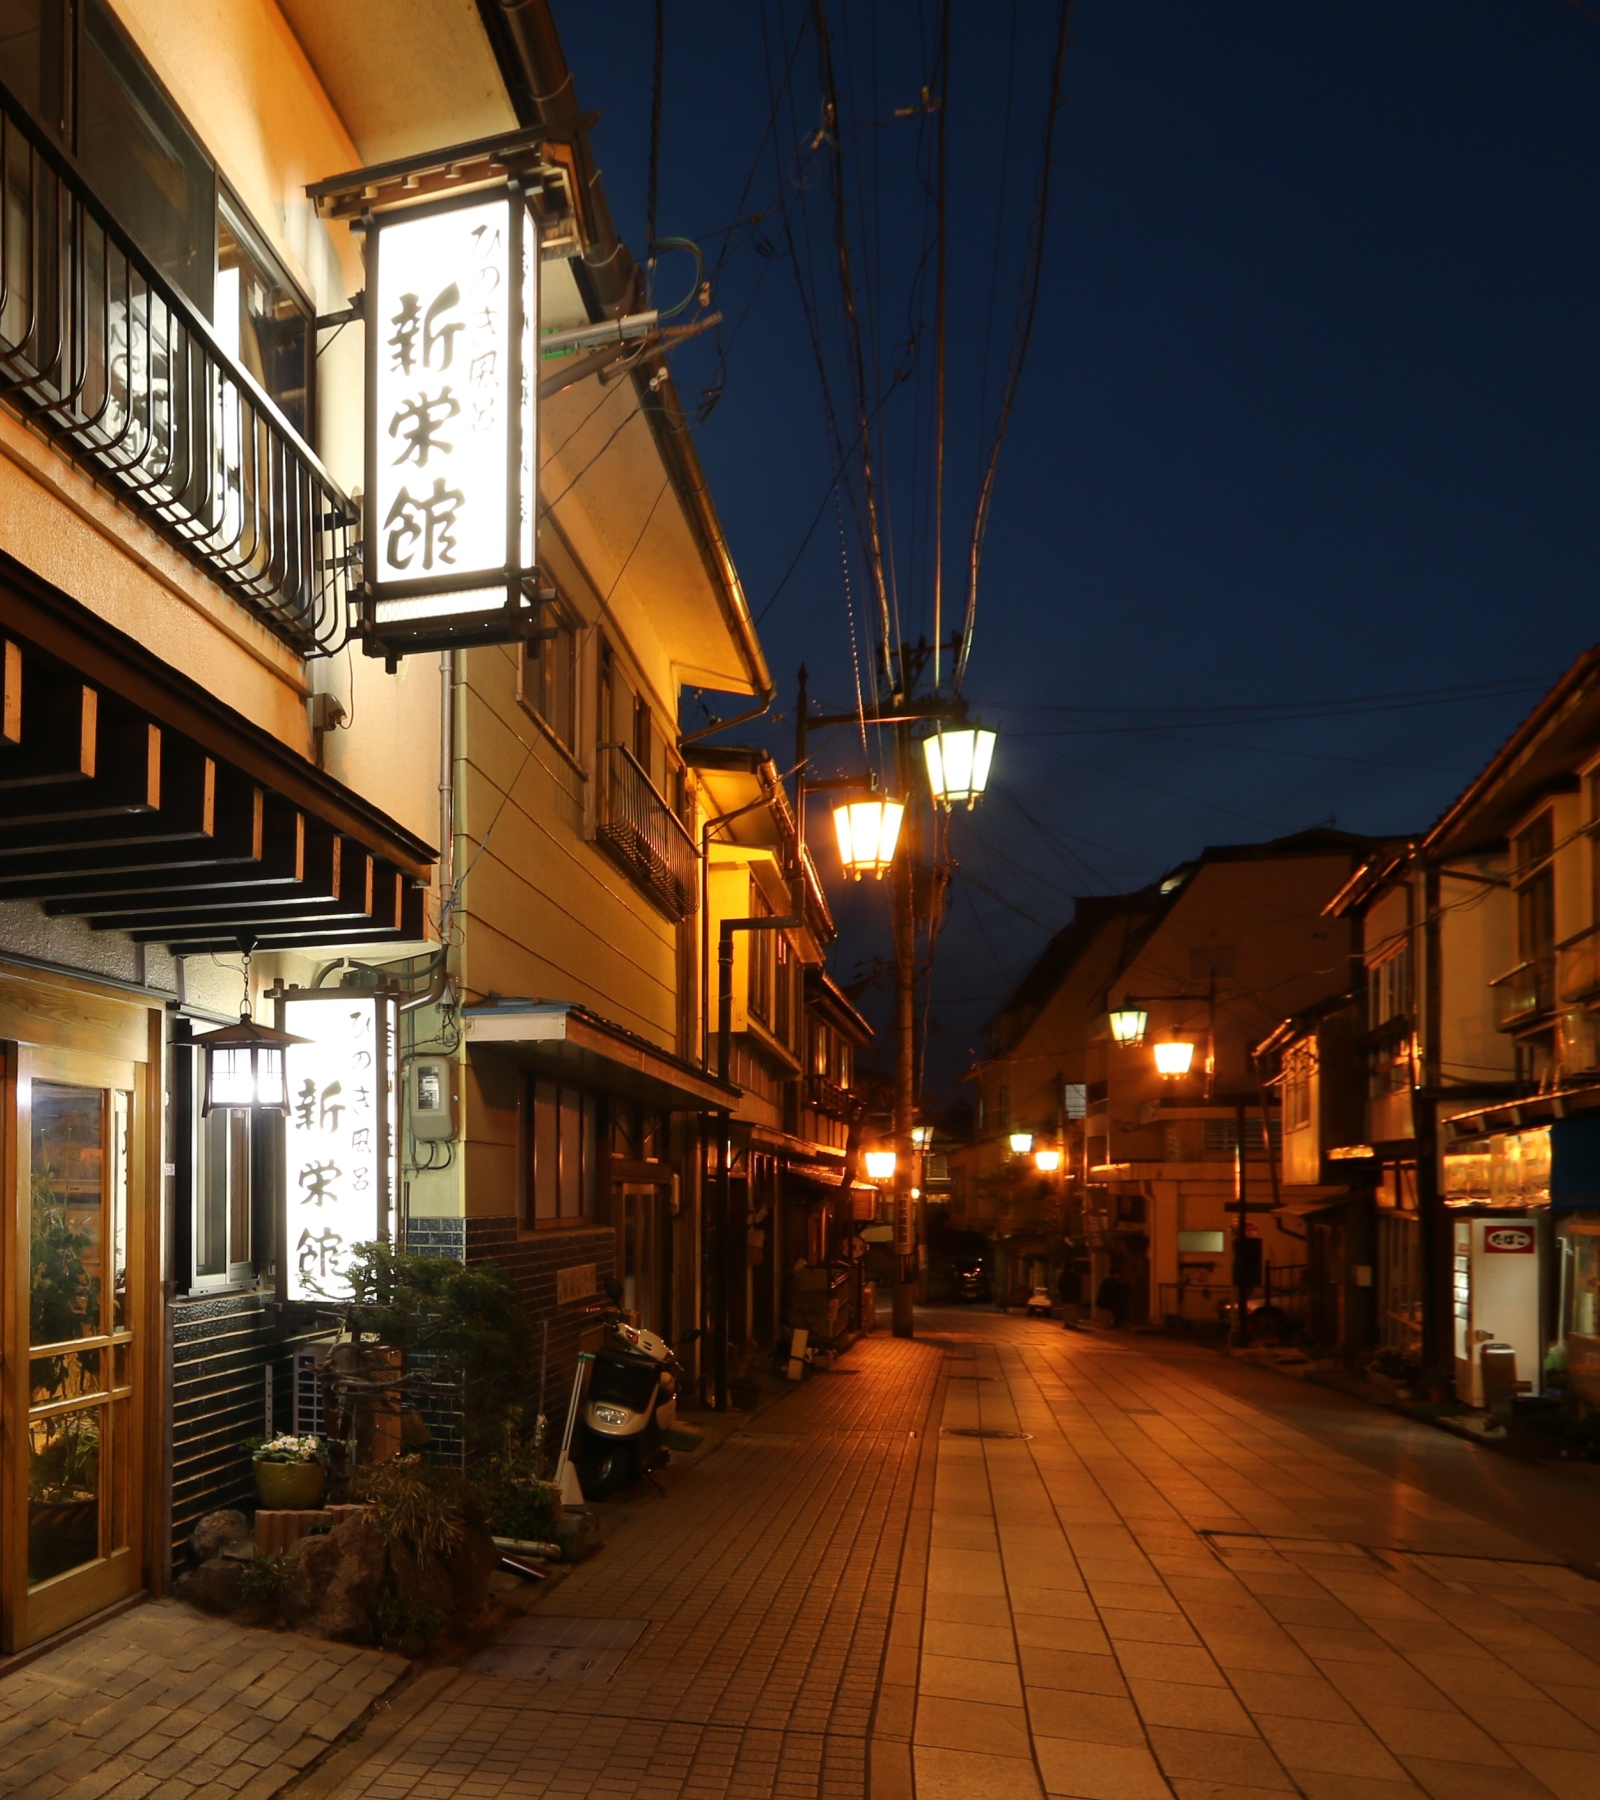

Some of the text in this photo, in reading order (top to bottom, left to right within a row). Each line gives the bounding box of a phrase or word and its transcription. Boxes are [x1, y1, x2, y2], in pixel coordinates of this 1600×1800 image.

[383, 281, 466, 571] 新栄館
[468, 223, 502, 433] ひのき風呂
[295, 1077, 346, 1279] 新栄館
[349, 1010, 372, 1192] ひのき風呂
[1491, 1232, 1526, 1246] たばこ
